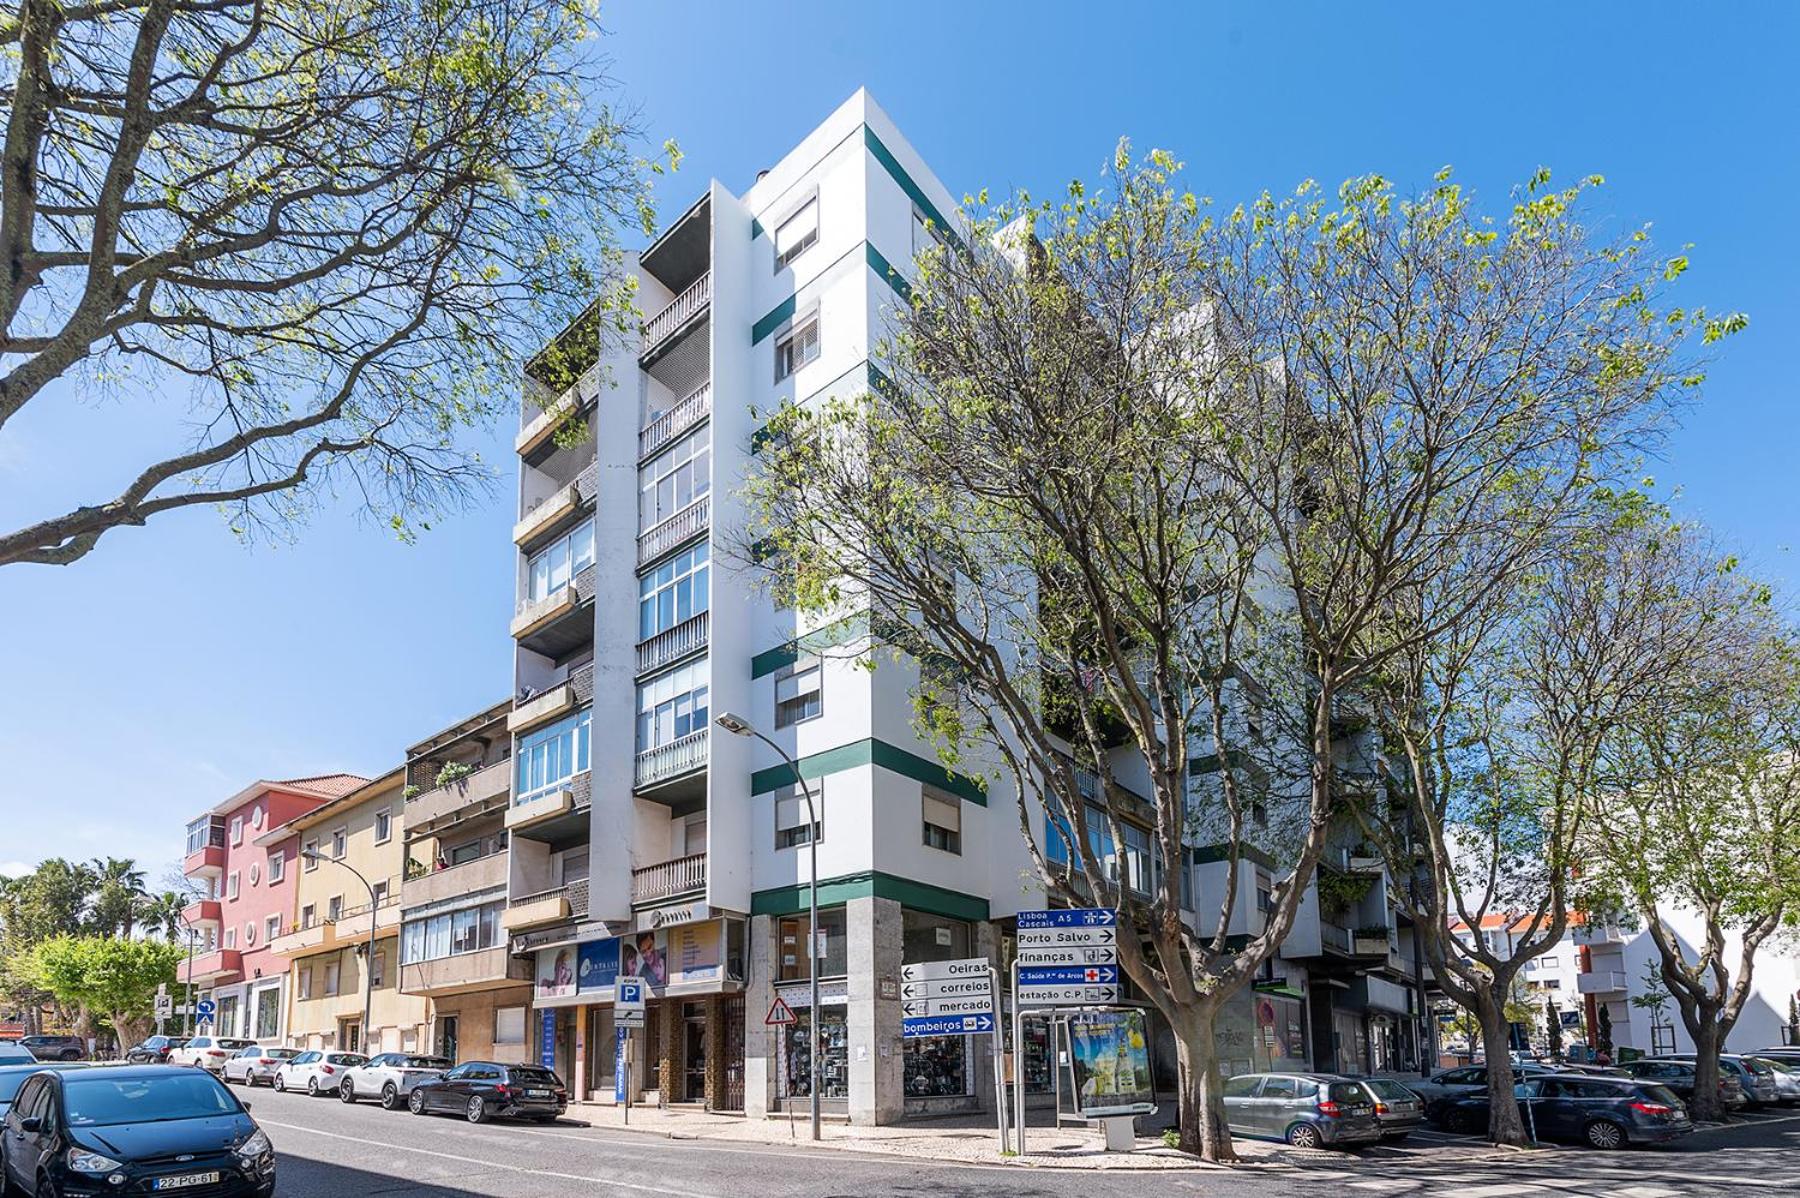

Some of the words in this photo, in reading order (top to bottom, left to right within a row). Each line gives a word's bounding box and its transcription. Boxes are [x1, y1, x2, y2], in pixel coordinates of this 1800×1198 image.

[1018, 912, 1048, 920] Lisboa
[1018, 920, 1055, 928] Cascais
[1018, 932, 1051, 944] Porto
[1057, 932, 1091, 943] Salvo
[1019, 951, 1074, 964] finanças
[948, 963, 989, 975] Oeiras
[624, 986, 636, 1001] P
[940, 981, 990, 994] correios
[1019, 991, 1060, 1001] estação
[1063, 990, 1084, 999] C.P.
[939, 1000, 991, 1013] mercado
[903, 1020, 961, 1034] bombeiros
